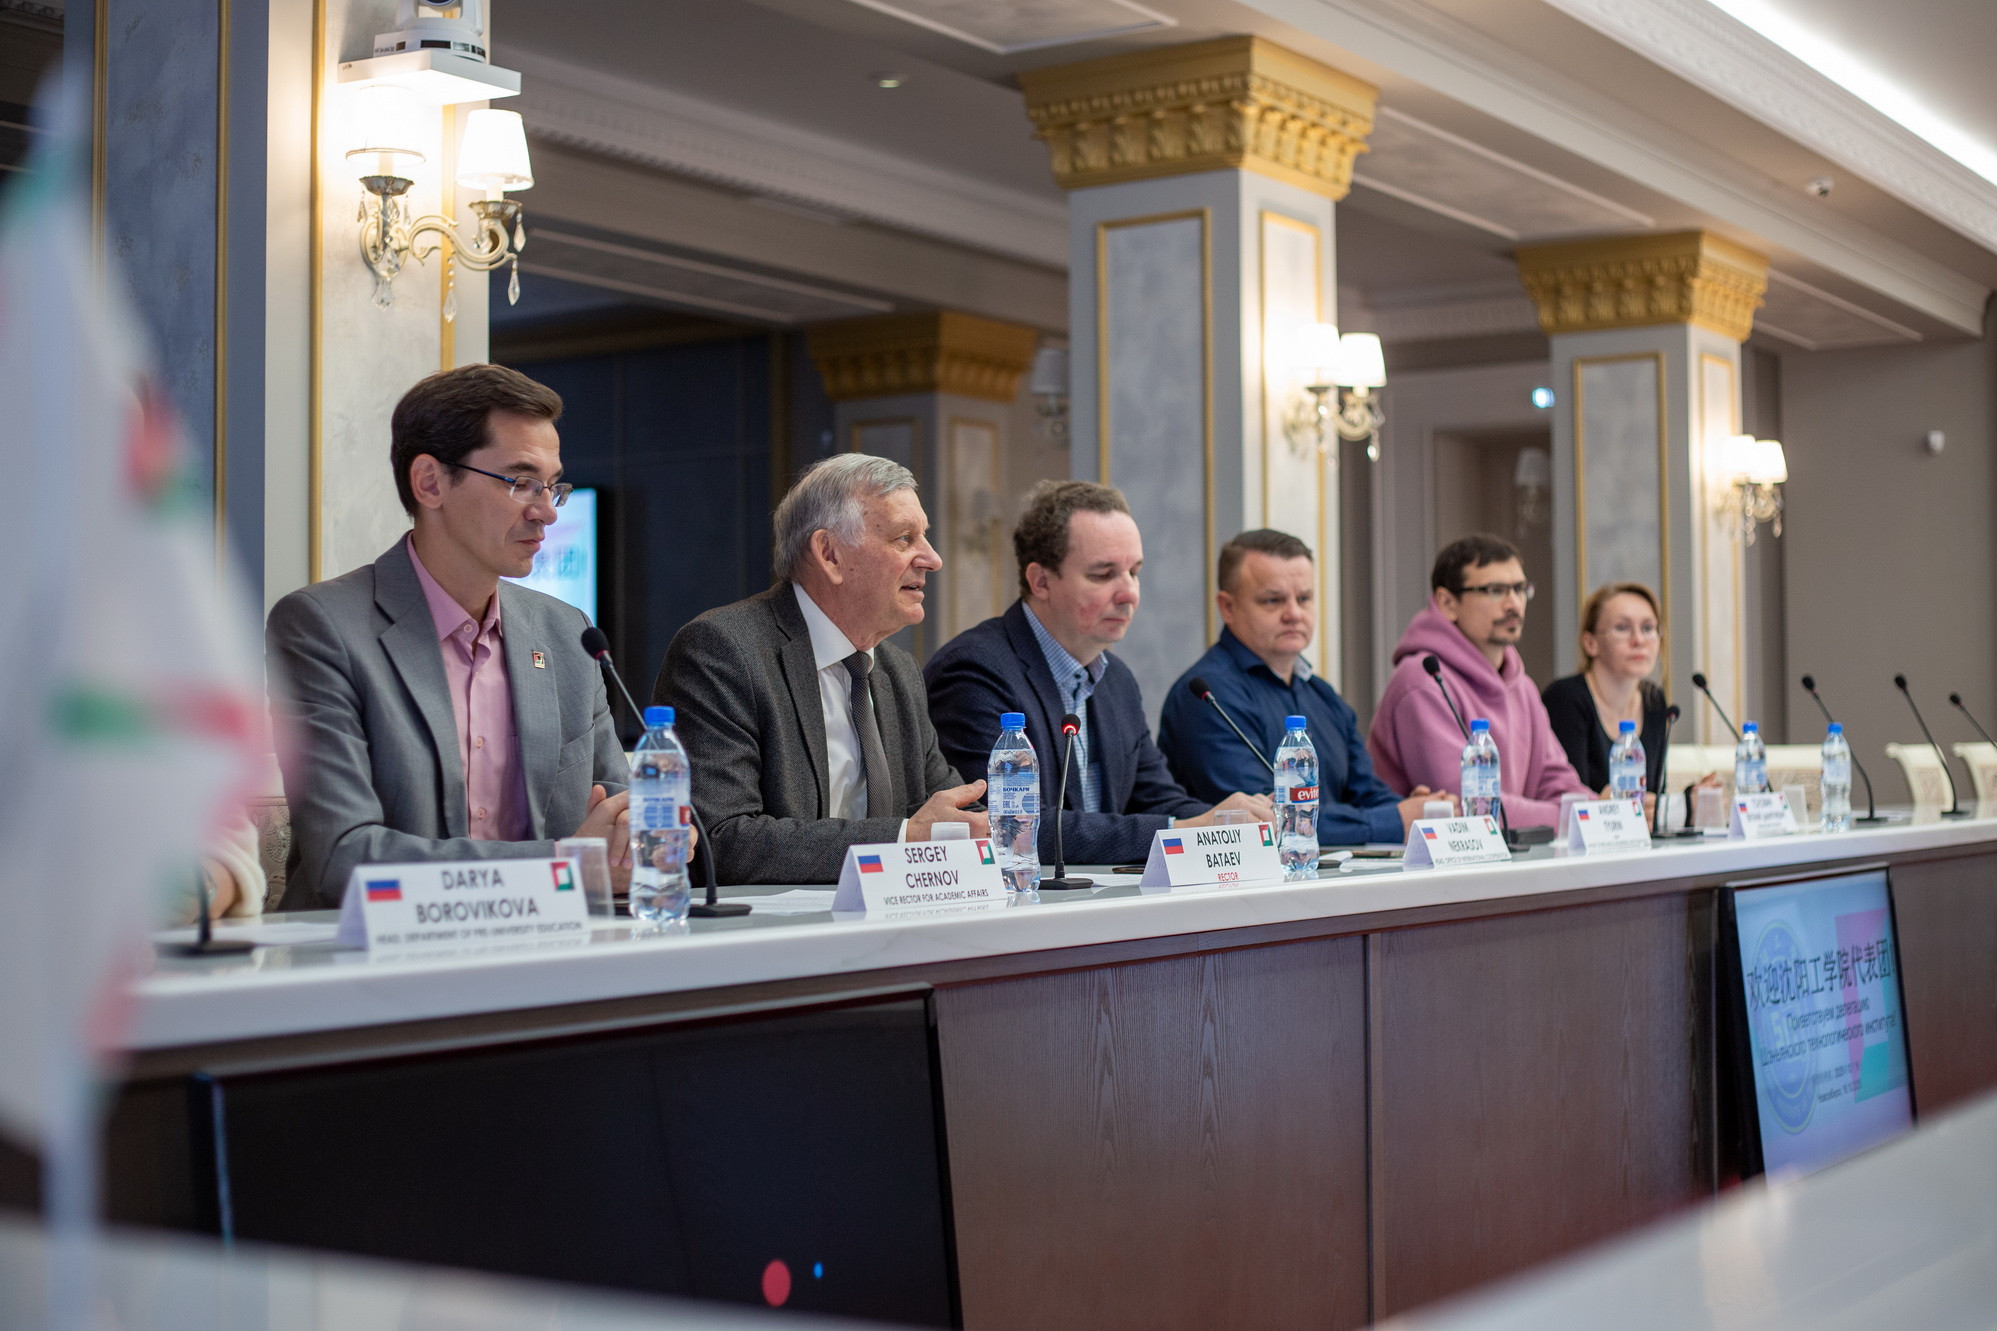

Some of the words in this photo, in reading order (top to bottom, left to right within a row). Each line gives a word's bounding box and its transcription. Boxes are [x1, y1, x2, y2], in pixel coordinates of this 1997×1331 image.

[1196, 829, 1241, 846] ANATOLIY
[904, 845, 948, 864] SERGEY
[1206, 851, 1241, 868] BATAEV
[441, 868, 505, 890] DARYA
[905, 870, 959, 889] CHERNOV
[1217, 871, 1239, 882] RECTOR
[883, 896, 898, 905] VICE
[899, 894, 921, 904] RECTOR
[922, 893, 934, 902] FOR
[935, 890, 966, 901] ACADEMIC
[967, 888, 989, 898] AFFAIRS
[416, 898, 540, 924] BOROVIKOVA
